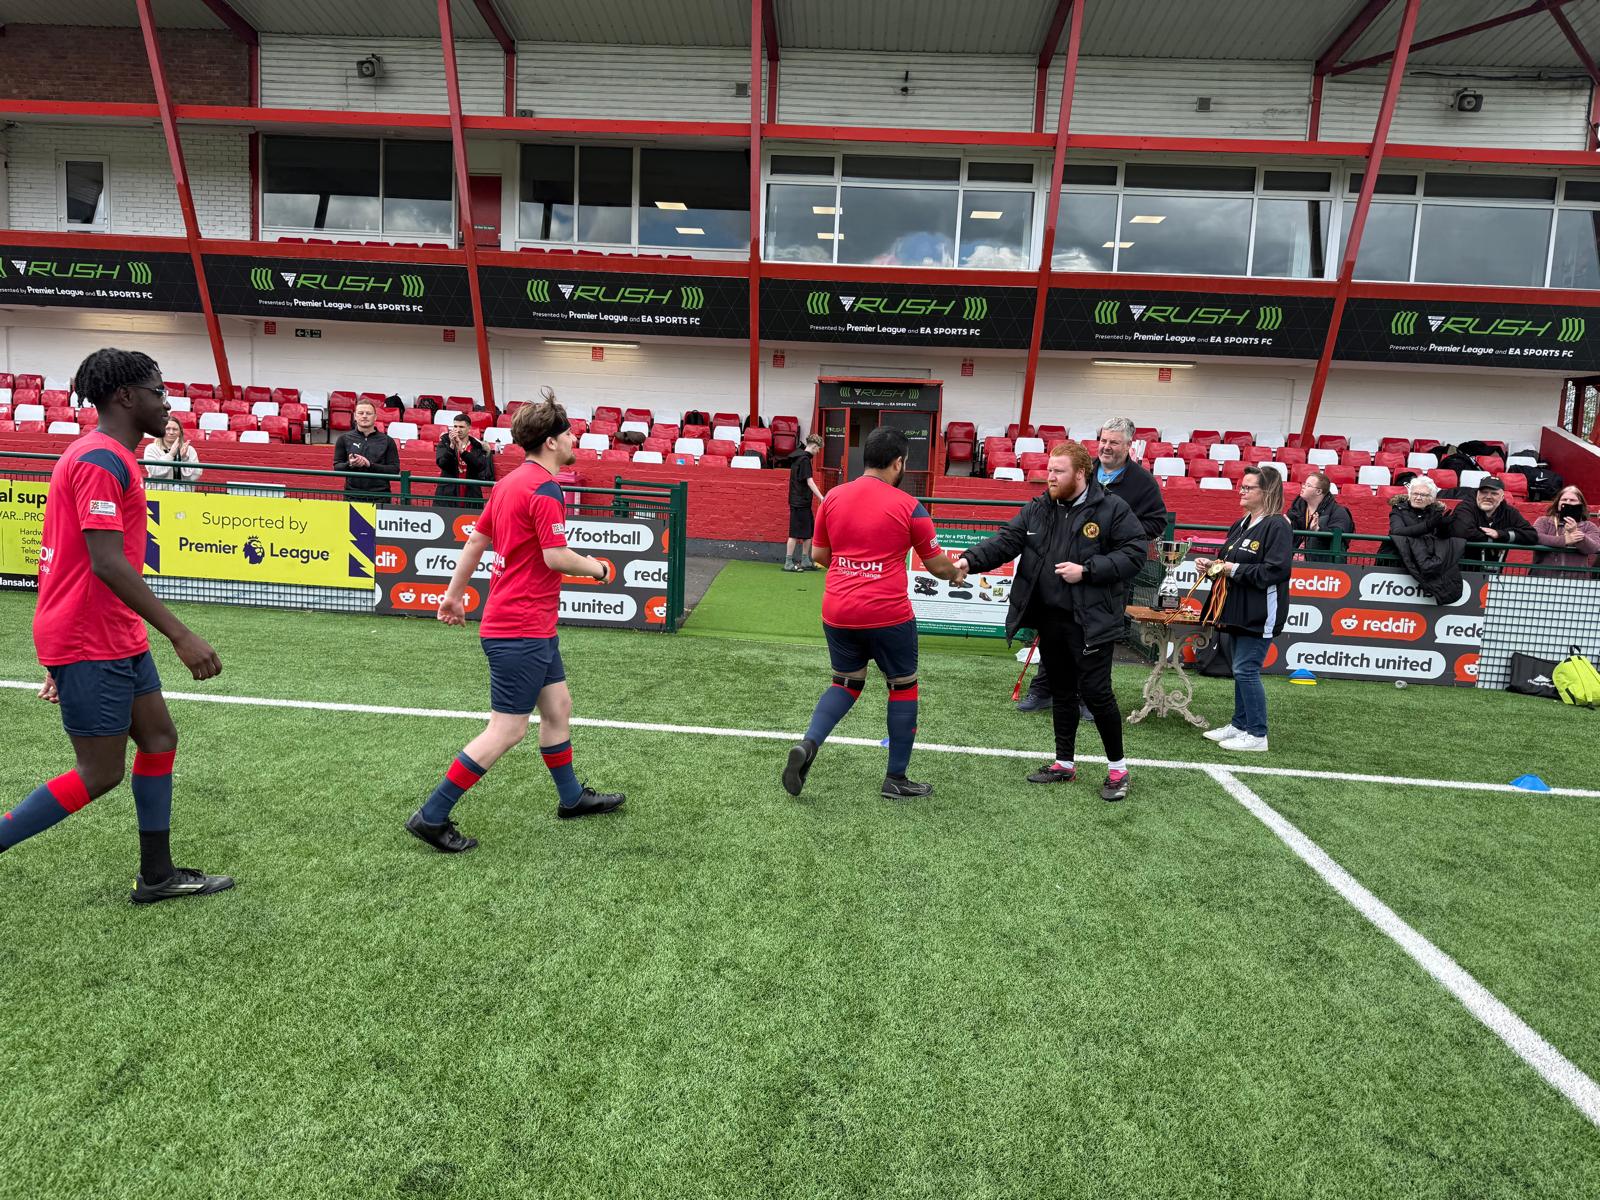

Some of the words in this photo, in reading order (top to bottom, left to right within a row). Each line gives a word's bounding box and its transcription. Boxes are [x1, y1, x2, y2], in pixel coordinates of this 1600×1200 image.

[27, 261, 121, 280] RUSH
[295, 273, 393, 292] RUSH
[27, 286, 55, 295] Premier
[56, 287, 84, 297] League
[109, 290, 141, 298] SPORTS
[142, 291, 153, 299] FC
[573, 285, 673, 304] RUSH
[293, 299, 322, 307] Premier
[323, 300, 352, 310] League
[378, 303, 411, 312] SPORTS
[852, 297, 956, 315] RUSH
[569, 311, 598, 320] Premier
[599, 312, 628, 322] League
[641, 315, 653, 323] EA
[654, 315, 688, 325] SPORTS
[689, 317, 701, 325] FC
[1142, 306, 1250, 325] RUSH
[846, 323, 876, 333] Premier
[877, 325, 907, 335] League
[933, 327, 968, 335] SPORTS
[969, 328, 980, 336] FC
[1440, 316, 1552, 337] RUSH
[1133, 332, 1164, 341] Premier
[1165, 333, 1196, 343] League
[1224, 336, 1259, 345] SPORTS
[1261, 337, 1273, 345] FC
[1428, 343, 1461, 353] Premier
[1462, 345, 1494, 355] League
[1523, 348, 1560, 357] SPORTS
[1561, 350, 1574, 358] FC
[860, 388, 906, 397] RUSH
[17, 492, 47, 508] sup
[202, 511, 284, 530] Supported
[289, 516, 308, 533] by
[378, 517, 432, 533] united
[179, 536, 238, 555] Premier
[270, 542, 330, 564] League
[838, 556, 883, 572] RICOH
[1289, 575, 1341, 593] reddit
[571, 599, 624, 615] united
[1363, 616, 1417, 634] reddit
[1297, 650, 1371, 669] redditch
[1375, 655, 1432, 673] united
